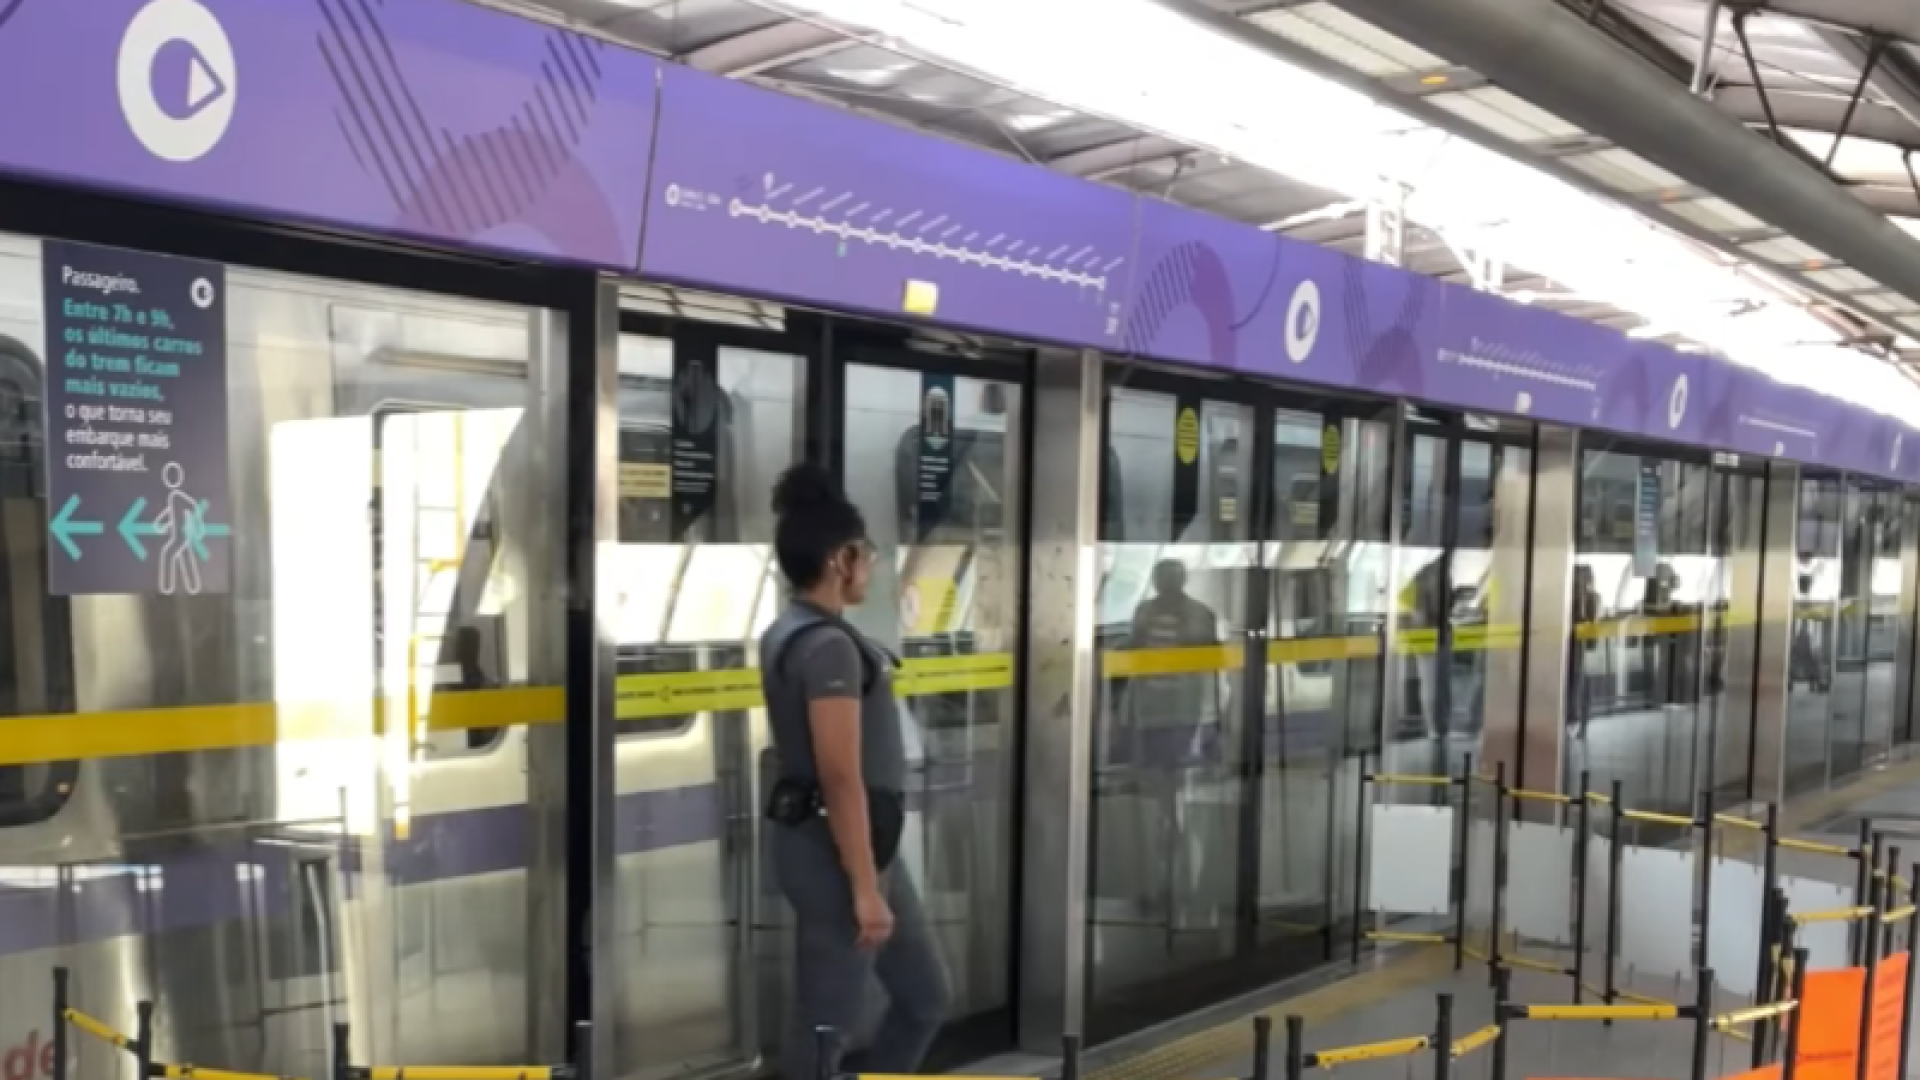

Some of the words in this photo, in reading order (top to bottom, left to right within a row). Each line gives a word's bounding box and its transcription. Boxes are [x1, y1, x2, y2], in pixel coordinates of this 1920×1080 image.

[63, 297, 108, 321] Entre
[112, 304, 132, 323] 7h
[137, 310, 147, 325] e
[65, 326, 84, 343] os
[88, 325, 149, 349] últimos
[154, 336, 203, 355] carros
[65, 348, 87, 368] do
[91, 353, 131, 372] trem
[134, 355, 180, 377] ficam
[65, 375, 104, 396] mais
[65, 403, 75, 419] o
[78, 405, 105, 426] que
[108, 405, 145, 423] torna
[148, 409, 173, 425] seu
[65, 425, 134, 450] embarque
[138, 430, 170, 450] mais
